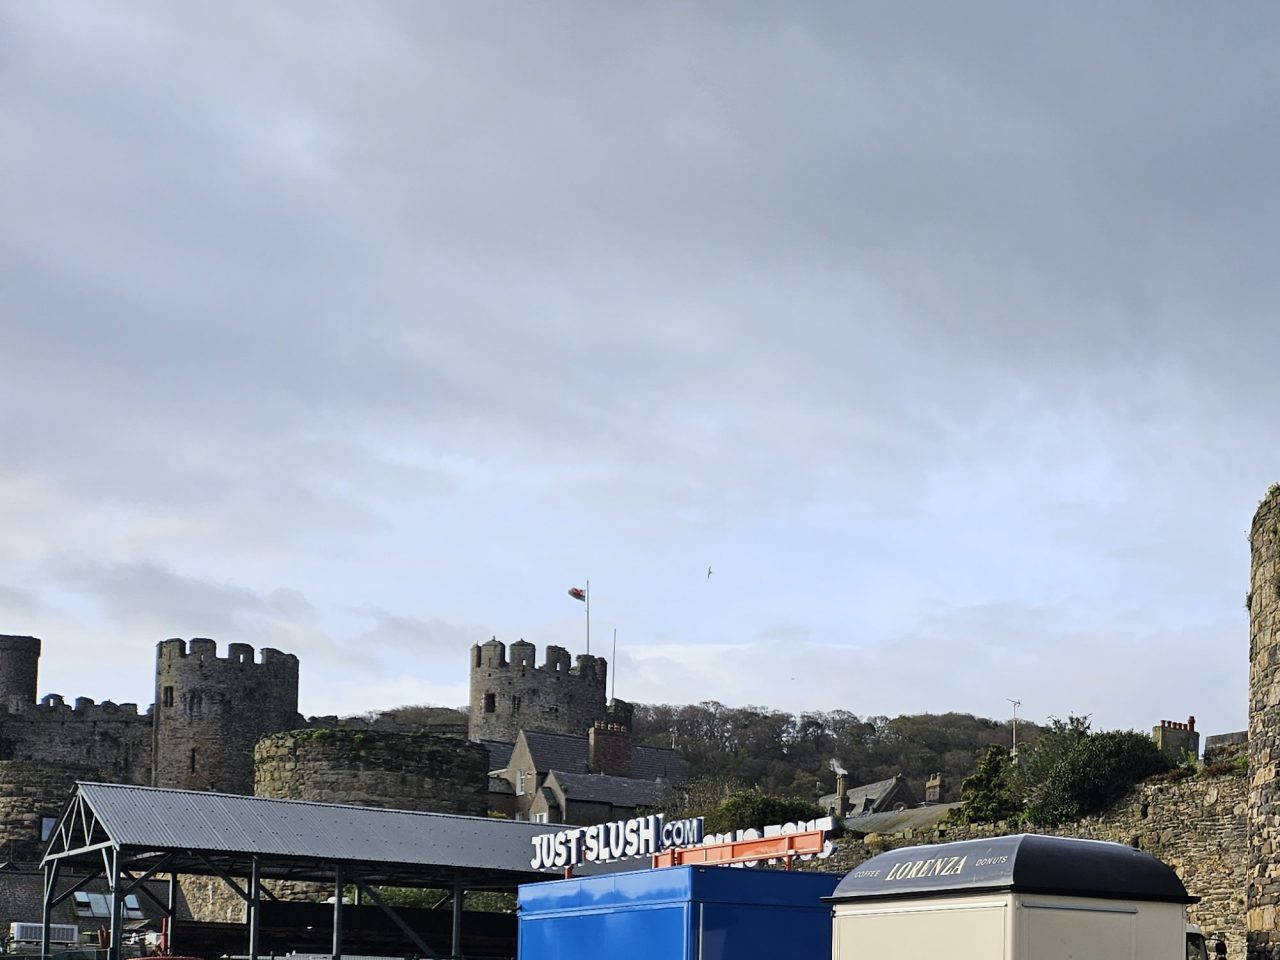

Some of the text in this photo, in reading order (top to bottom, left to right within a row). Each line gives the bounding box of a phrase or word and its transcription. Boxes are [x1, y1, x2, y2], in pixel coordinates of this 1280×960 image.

[530, 828, 584, 870] JUST
[585, 814, 660, 862] SLUSH
[854, 855, 1008, 881] COFFEE LORENZA DONUTS
